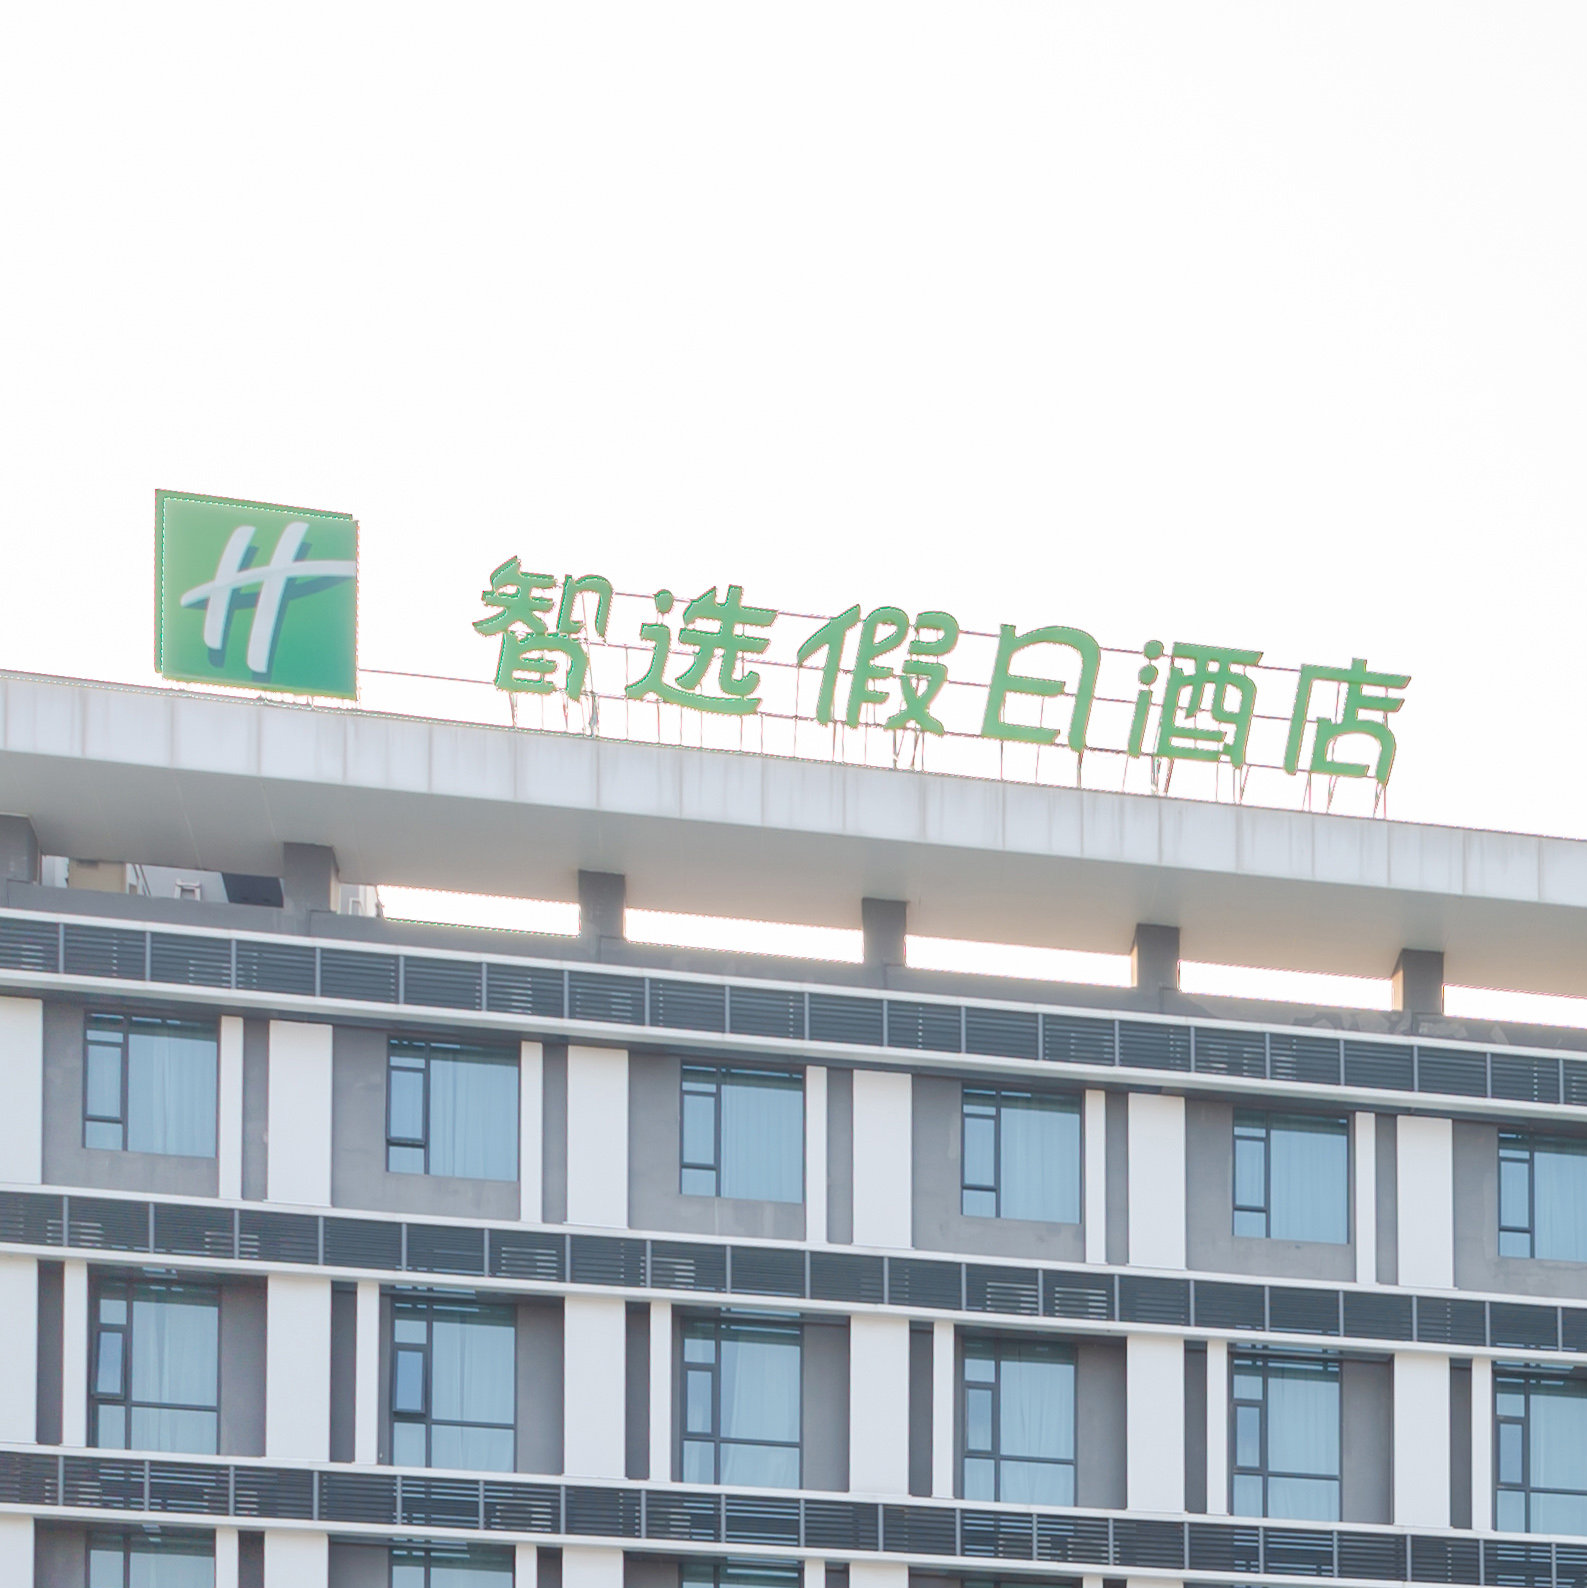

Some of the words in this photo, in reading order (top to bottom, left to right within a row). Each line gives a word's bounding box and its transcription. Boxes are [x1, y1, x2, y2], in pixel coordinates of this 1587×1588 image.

[473, 554, 1412, 784] 智选假日酒店
